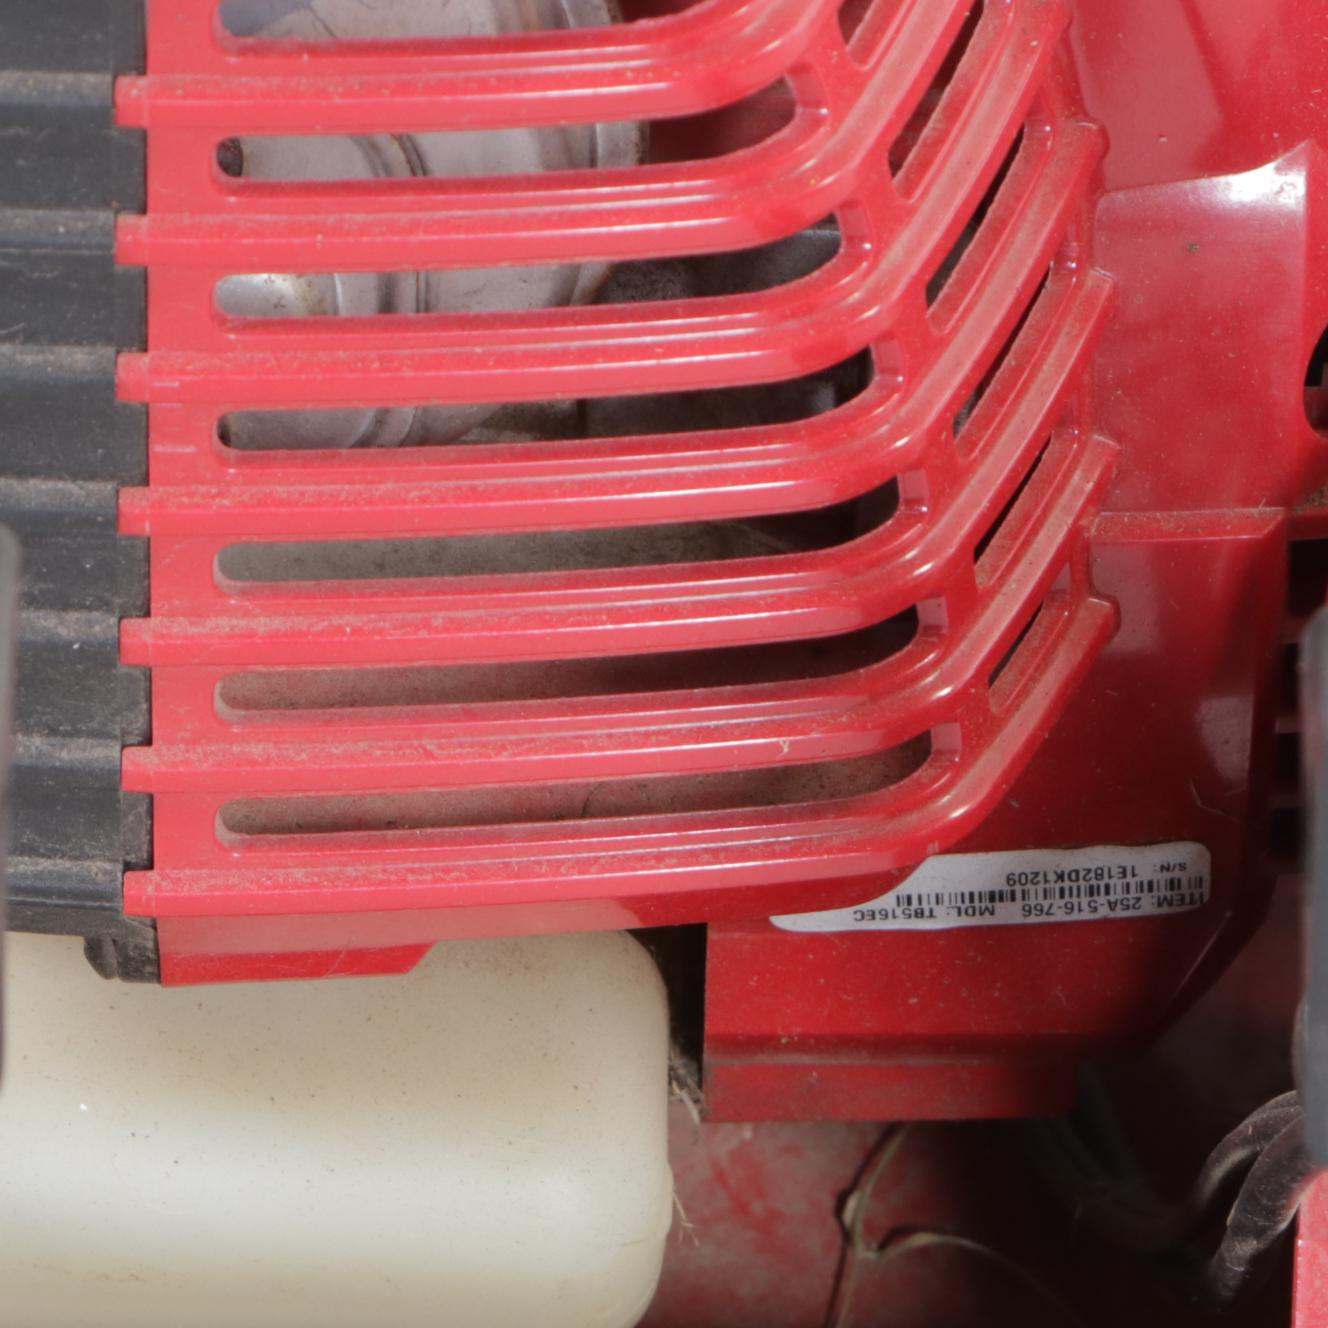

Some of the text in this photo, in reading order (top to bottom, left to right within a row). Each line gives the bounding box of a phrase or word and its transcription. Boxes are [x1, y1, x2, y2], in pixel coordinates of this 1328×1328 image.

[1005, 861, 1188, 887] S/N: 1E182DK1209
[852, 891, 1204, 922] ITEM: 25A-516-766 MDL: TB516EC
